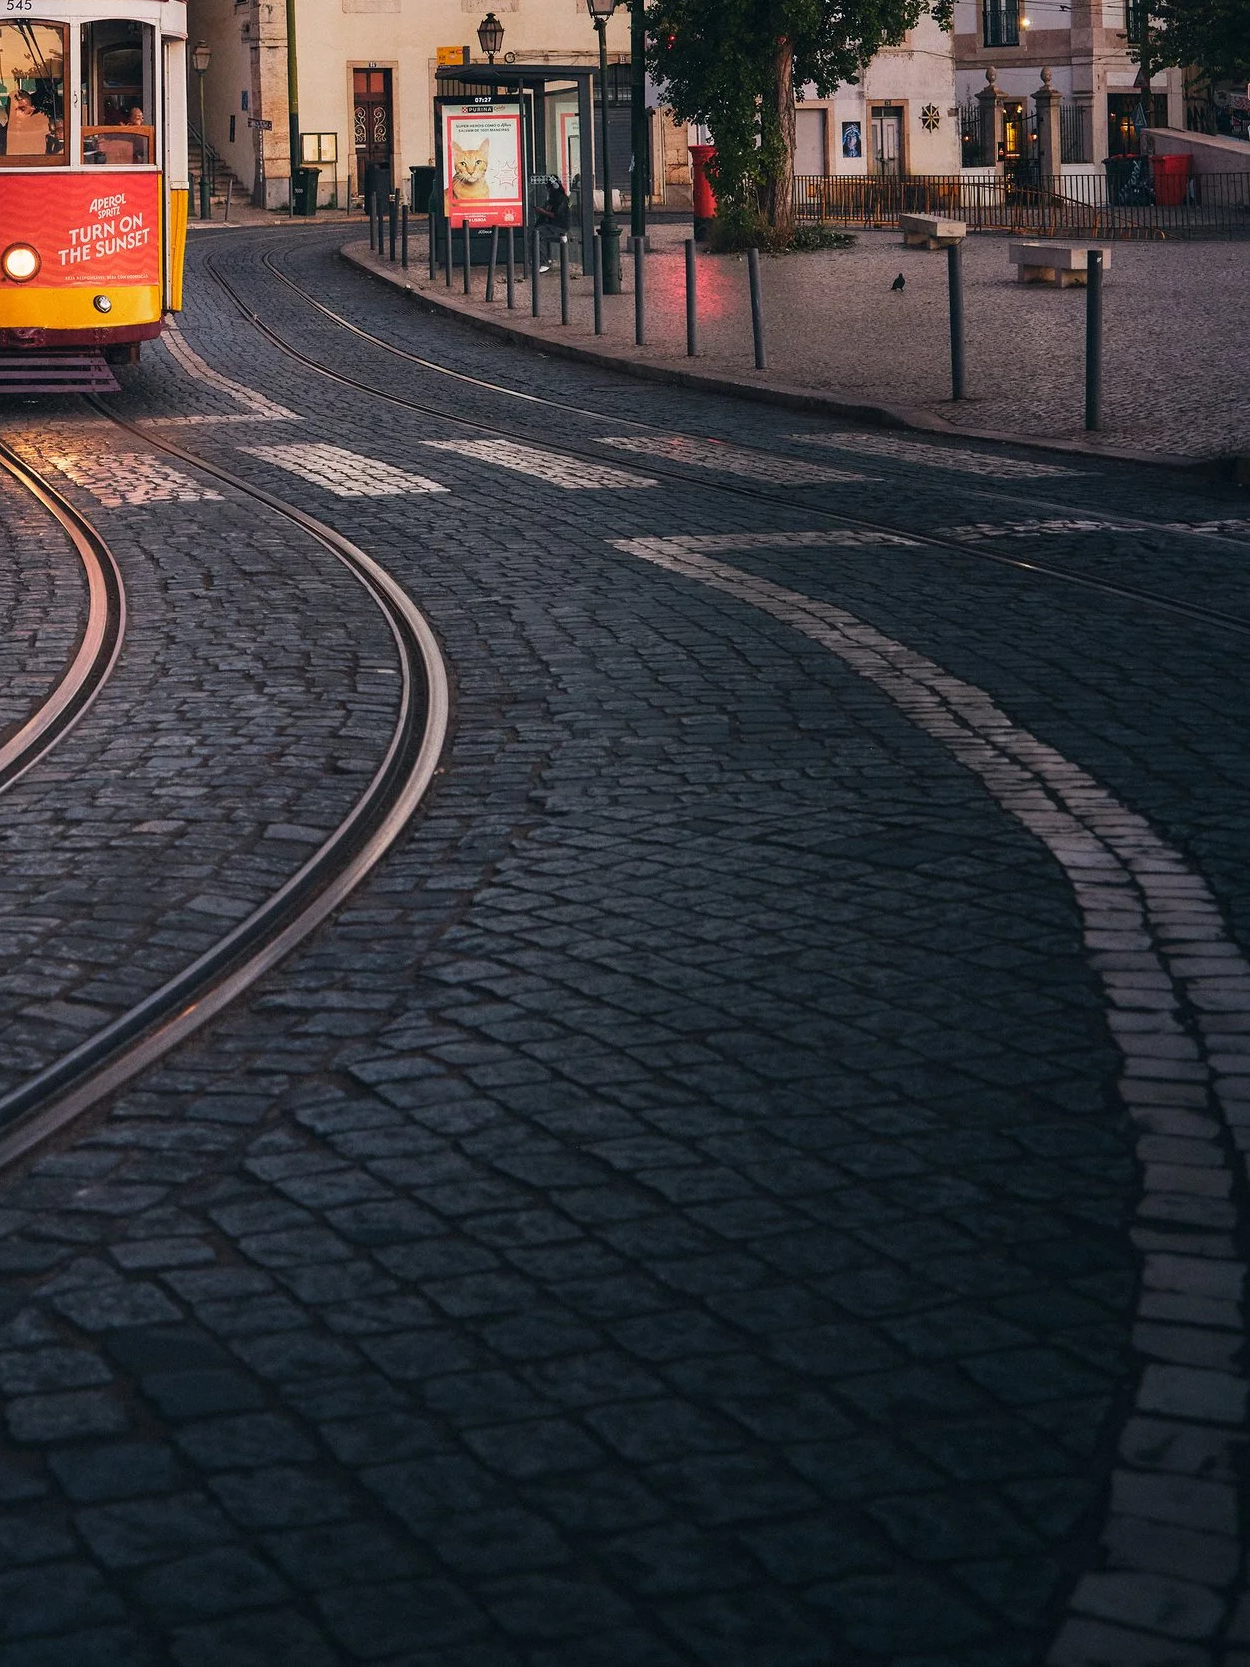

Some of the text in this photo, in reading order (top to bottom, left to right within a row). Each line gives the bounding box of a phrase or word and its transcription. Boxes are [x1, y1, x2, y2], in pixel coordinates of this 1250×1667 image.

[6, 0, 33, 11] 545
[89, 193, 127, 213] APEROL
[97, 206, 120, 220] SPRITZ
[68, 212, 143, 245] TURN ON
[58, 227, 150, 266] THE SUNSET
